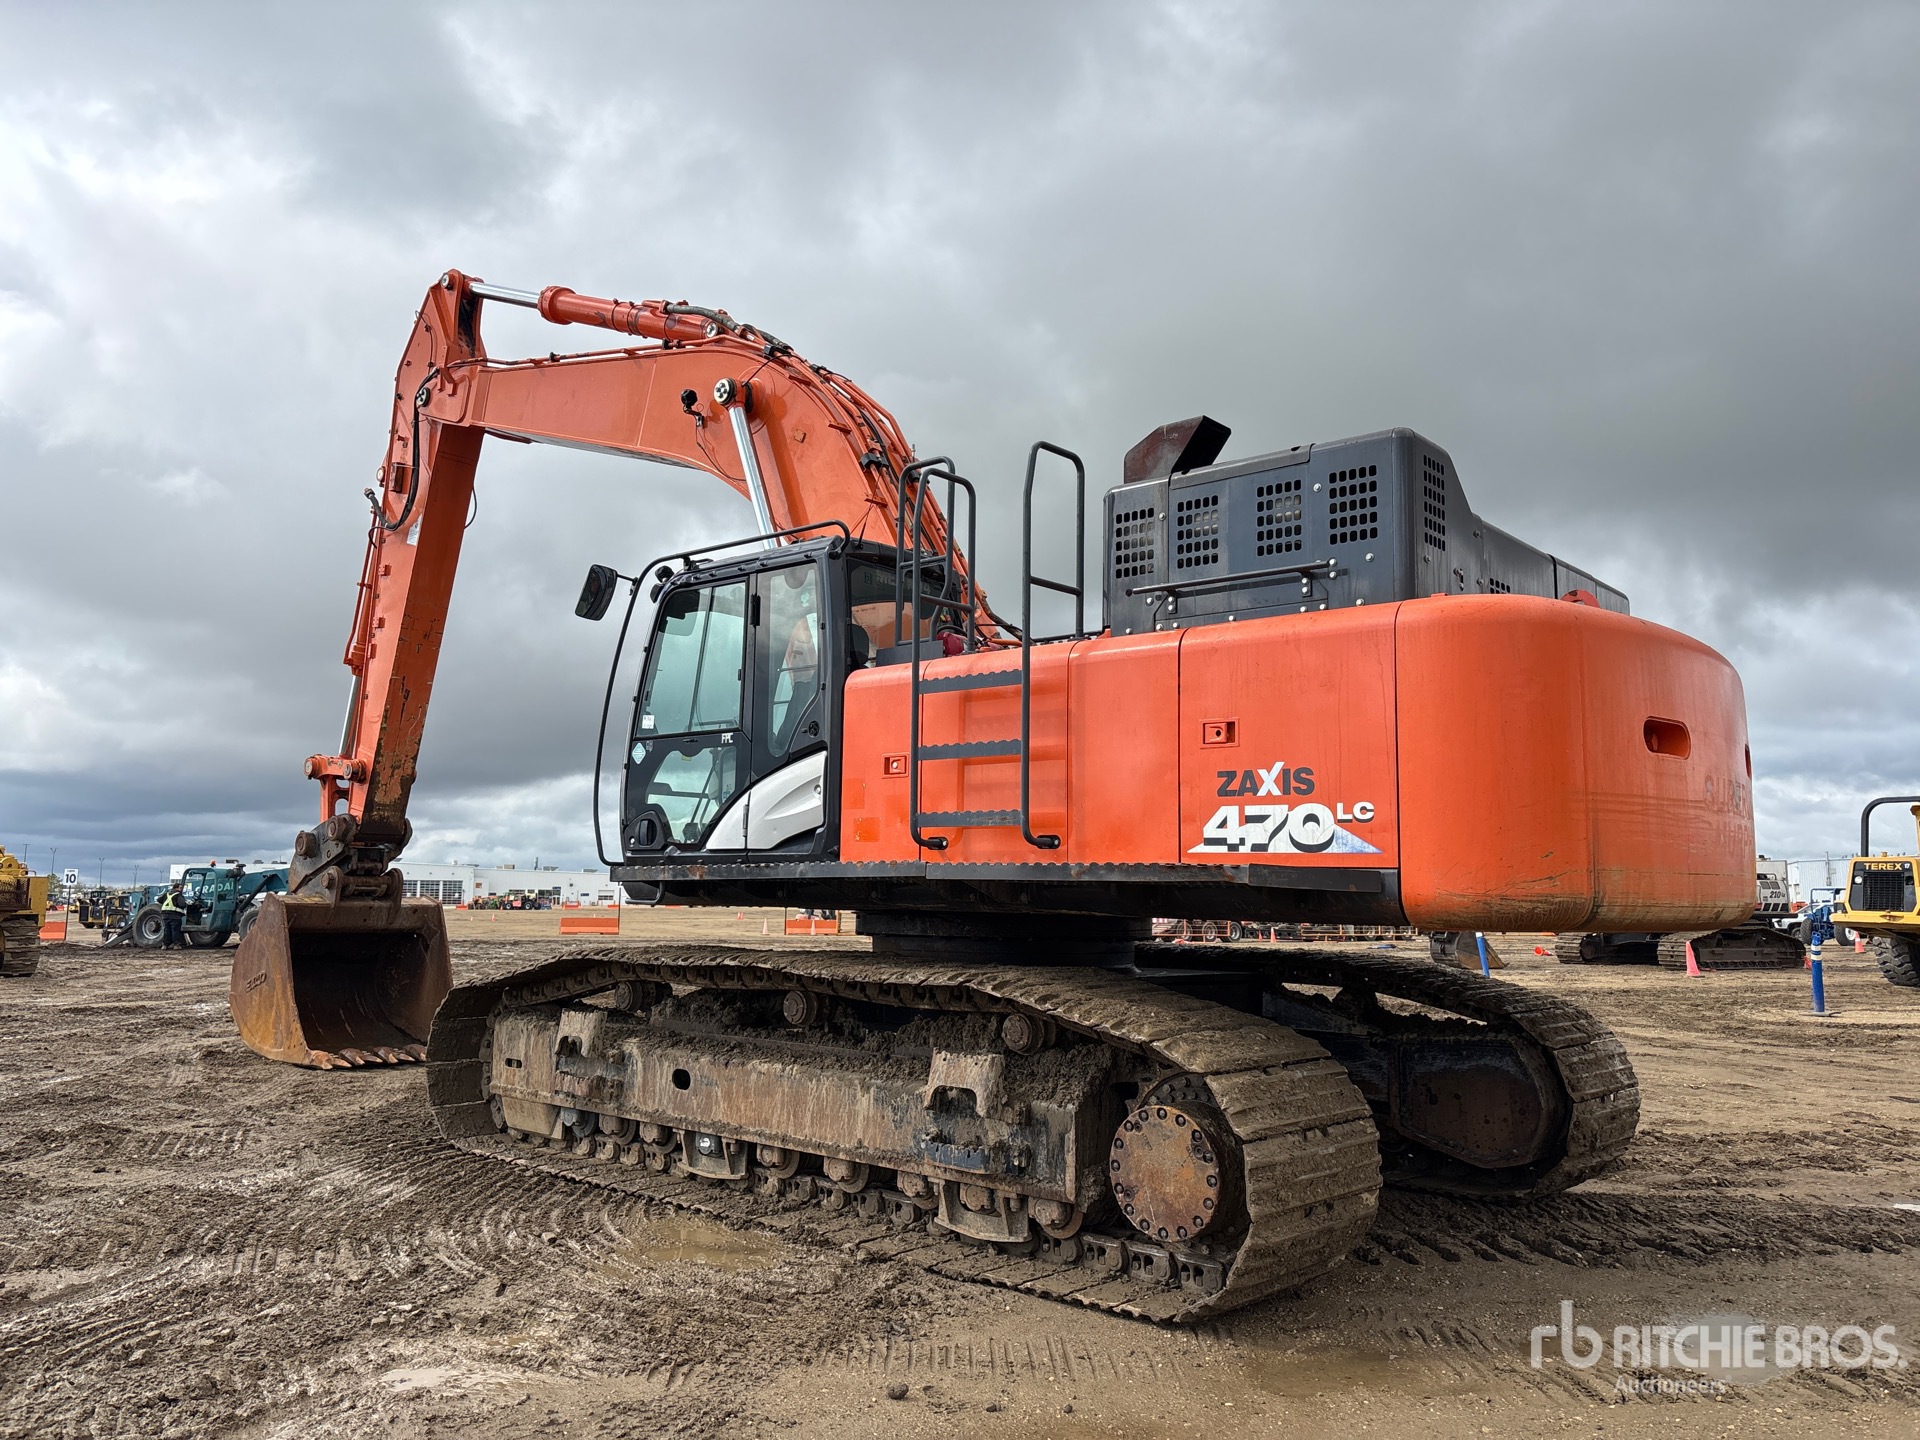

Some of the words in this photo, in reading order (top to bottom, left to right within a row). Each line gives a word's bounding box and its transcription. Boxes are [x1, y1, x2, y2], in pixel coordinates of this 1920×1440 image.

[1216, 761, 1316, 797] ZAXIS
[1202, 802, 1335, 853] 470
[1336, 801, 1375, 823] LC
[1863, 862, 1903, 871] TEREX
[65, 873, 77, 884] 10
[1769, 890, 1782, 899] 210
